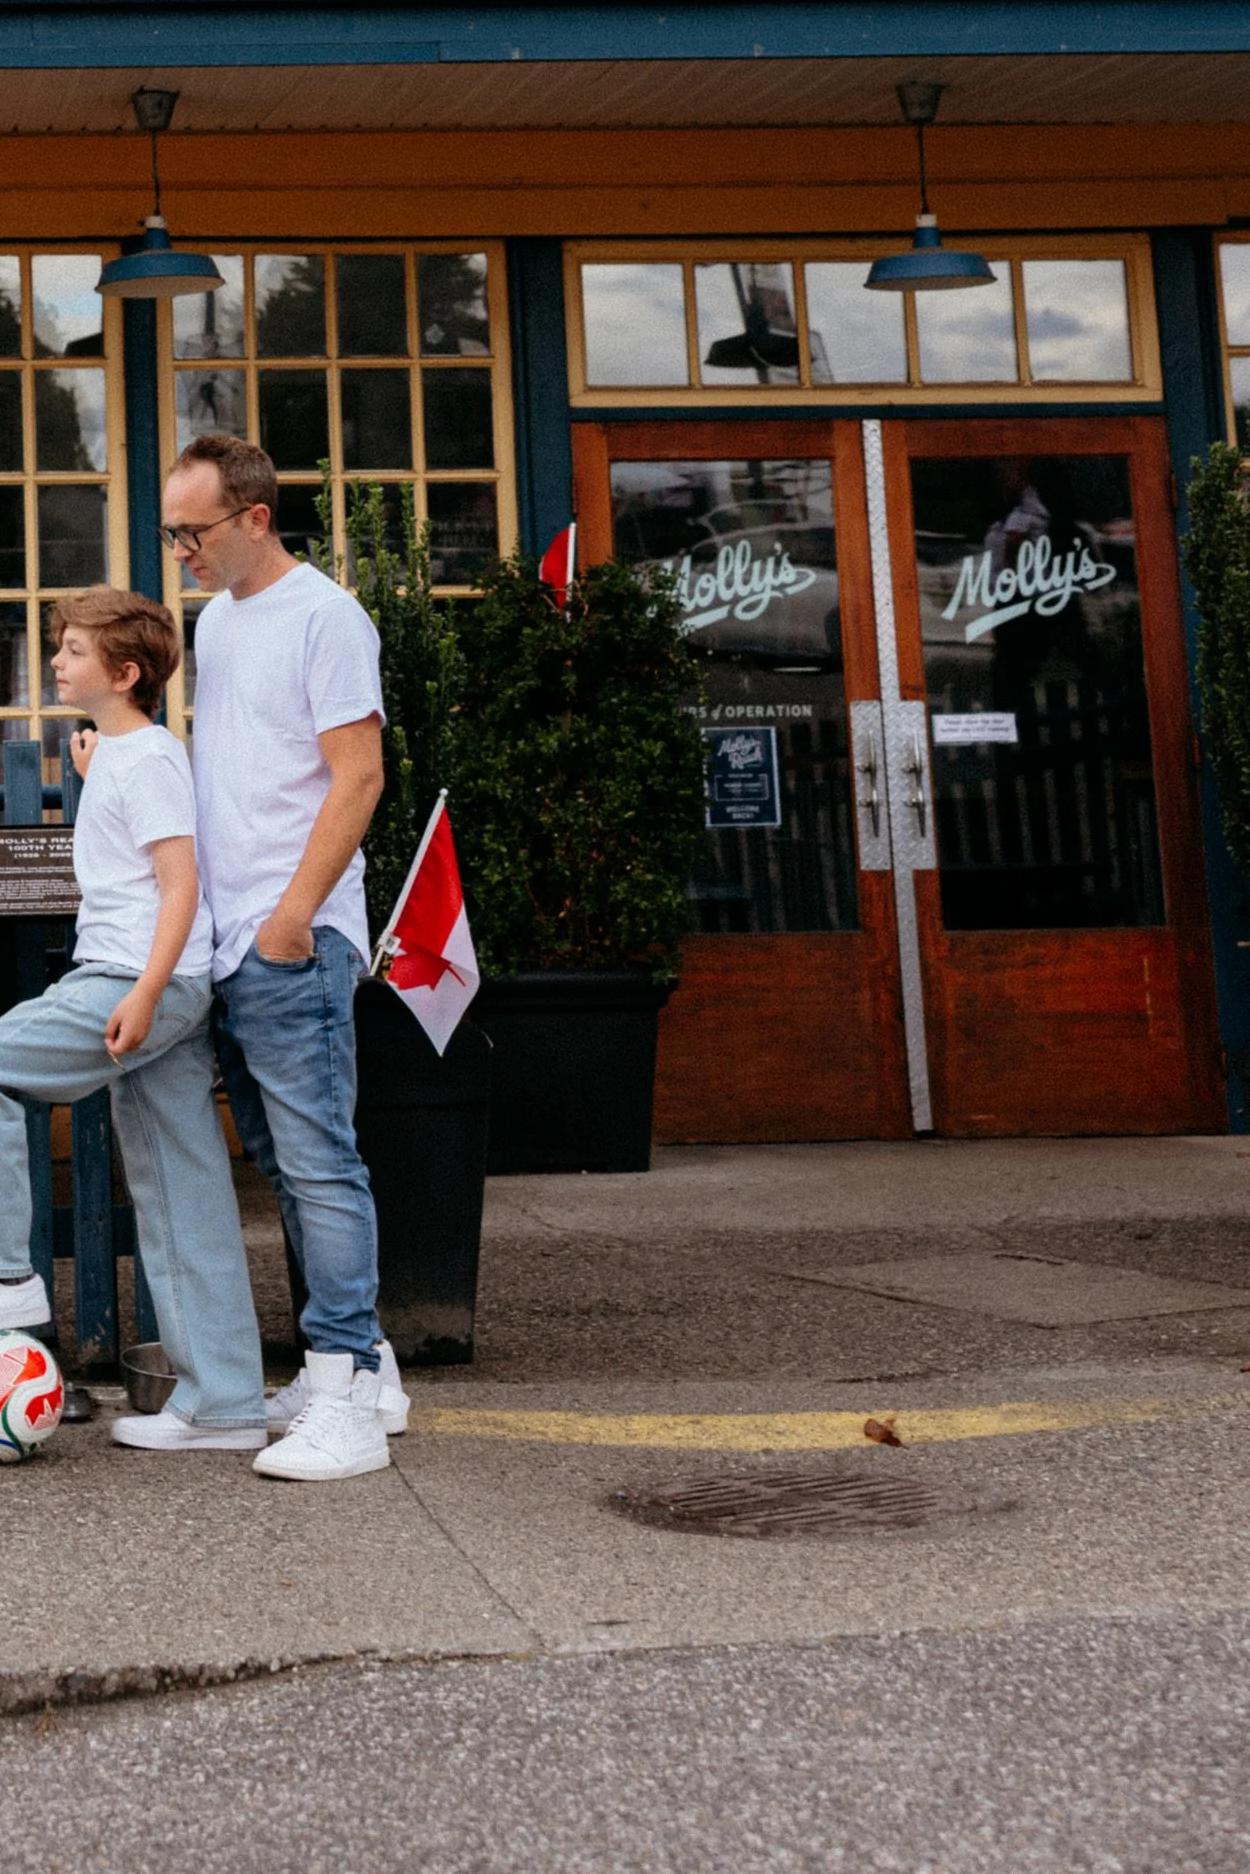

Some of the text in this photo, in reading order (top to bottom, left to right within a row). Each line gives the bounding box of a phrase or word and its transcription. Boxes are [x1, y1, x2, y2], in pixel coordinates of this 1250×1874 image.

[941, 534, 1117, 644] Molly's
[725, 704, 813, 718] OPERATION
[50, 836, 74, 844] REA
